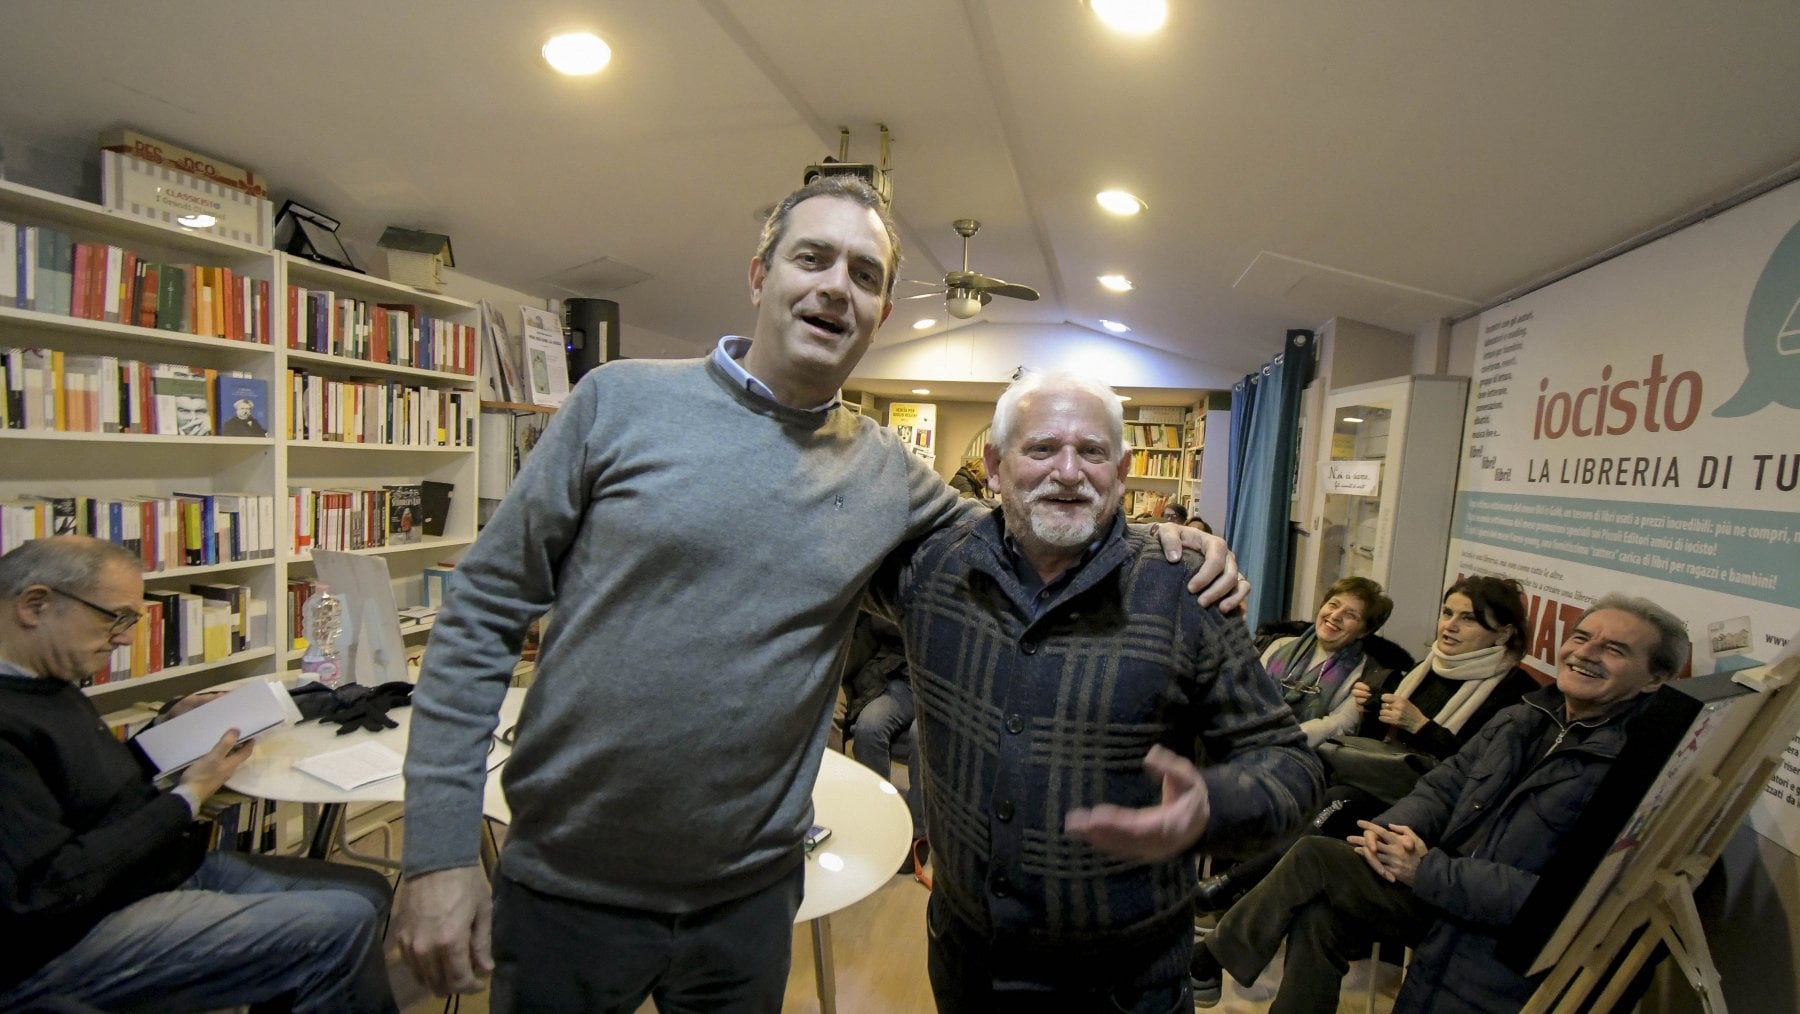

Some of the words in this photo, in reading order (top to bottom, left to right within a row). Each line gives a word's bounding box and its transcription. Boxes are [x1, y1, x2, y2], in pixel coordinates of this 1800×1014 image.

[1533, 354, 1703, 440] iocisto
[1527, 458, 1550, 483] LA
[1560, 456, 1679, 488] LIBRERIA
[1697, 455, 1733, 489] DI
[1753, 454, 1800, 492] TU
[1734, 525, 1747, 537] ne
[1748, 526, 1791, 545] compri,
[1669, 560, 1686, 575] per
[1686, 563, 1720, 580] ragazzi
[1720, 569, 1728, 581] e
[1728, 567, 1778, 591] bambini!
